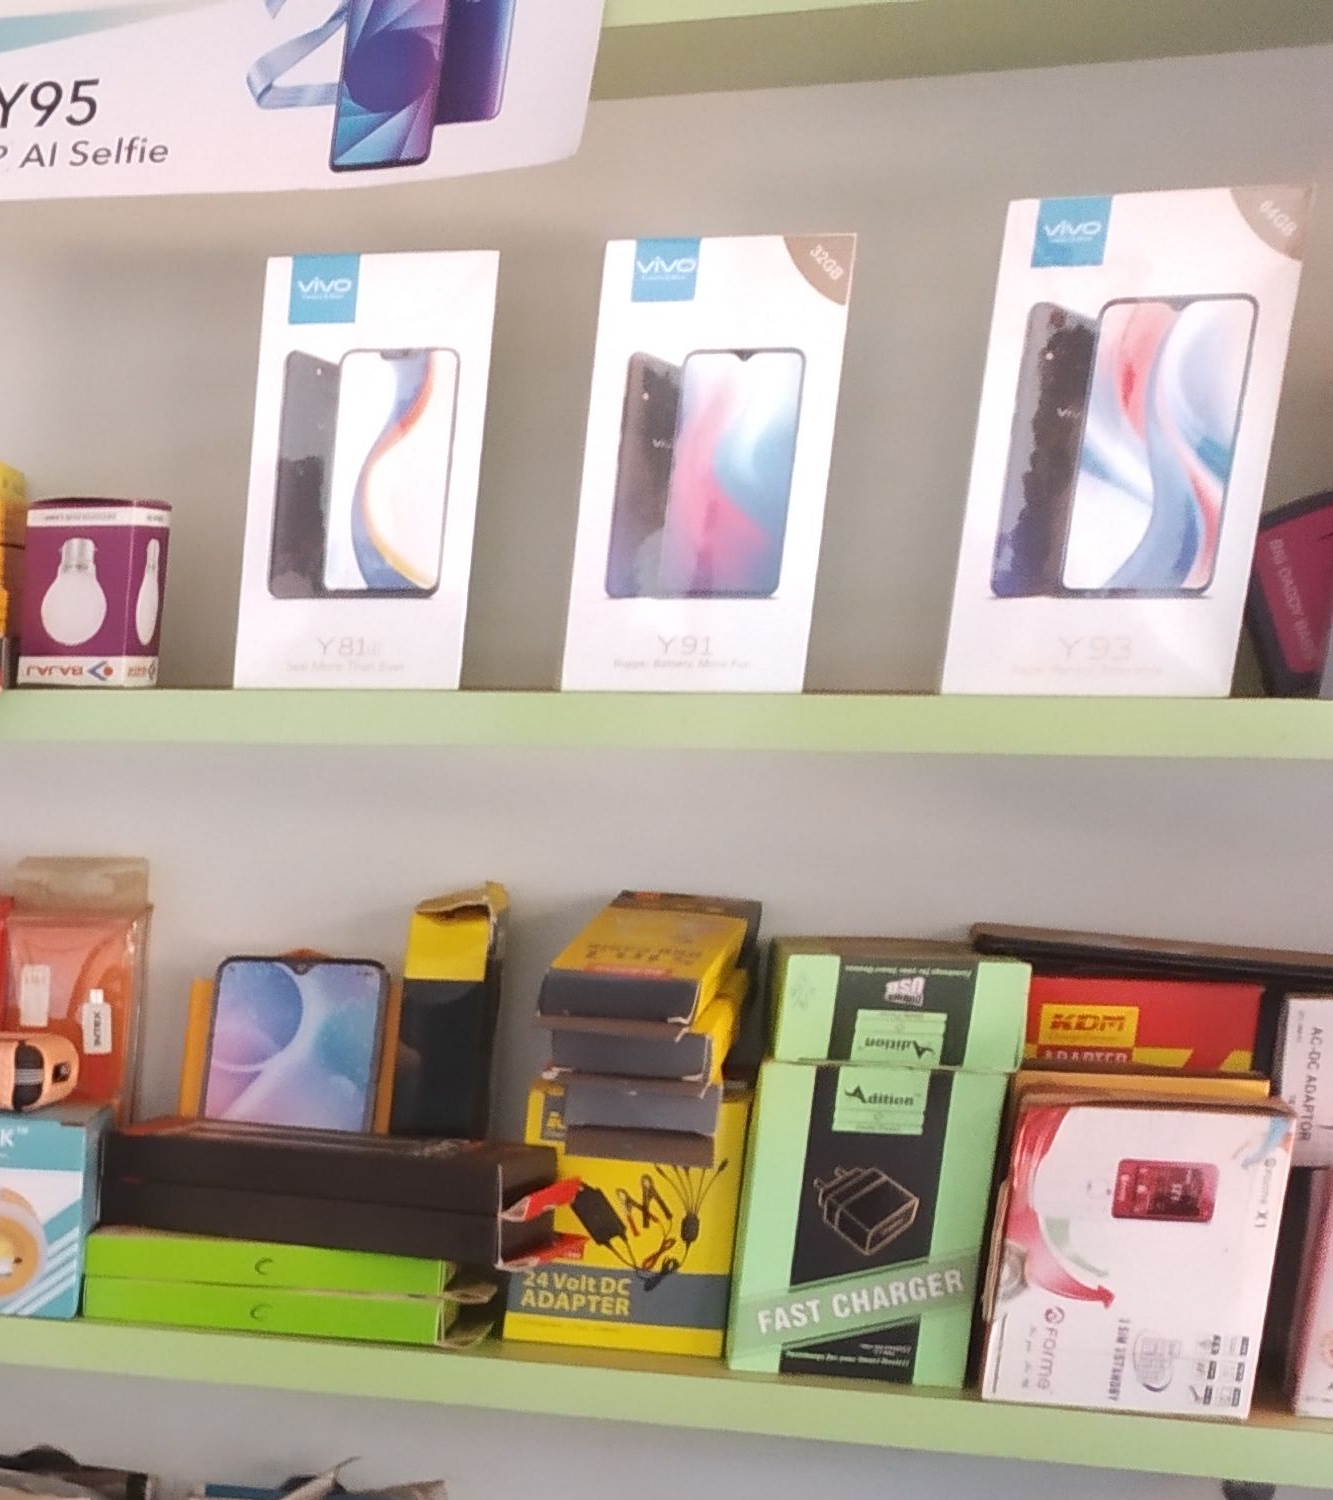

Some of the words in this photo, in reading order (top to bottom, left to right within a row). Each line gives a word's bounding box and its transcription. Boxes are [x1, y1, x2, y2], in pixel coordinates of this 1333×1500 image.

[19, 142, 58, 169] AI
[69, 137, 169, 168] Selfie
[1044, 220, 1102, 237] vivo
[636, 256, 696, 275] vivo
[810, 243, 844, 283] 32GB
[296, 276, 352, 294] vivo
[27, 664, 84, 678] BAJAJ
[1049, 1012, 1125, 1033] KDM
[864, 1038, 933, 1060] Adition
[845, 1084, 915, 1107] Adition
[523, 1271, 550, 1288] 24
[553, 1273, 597, 1292] Volt
[600, 1277, 631, 1296] DC
[520, 1289, 631, 1317] ADAPTER
[757, 1300, 821, 1335] FAST
[832, 1269, 964, 1320] CHARGER
